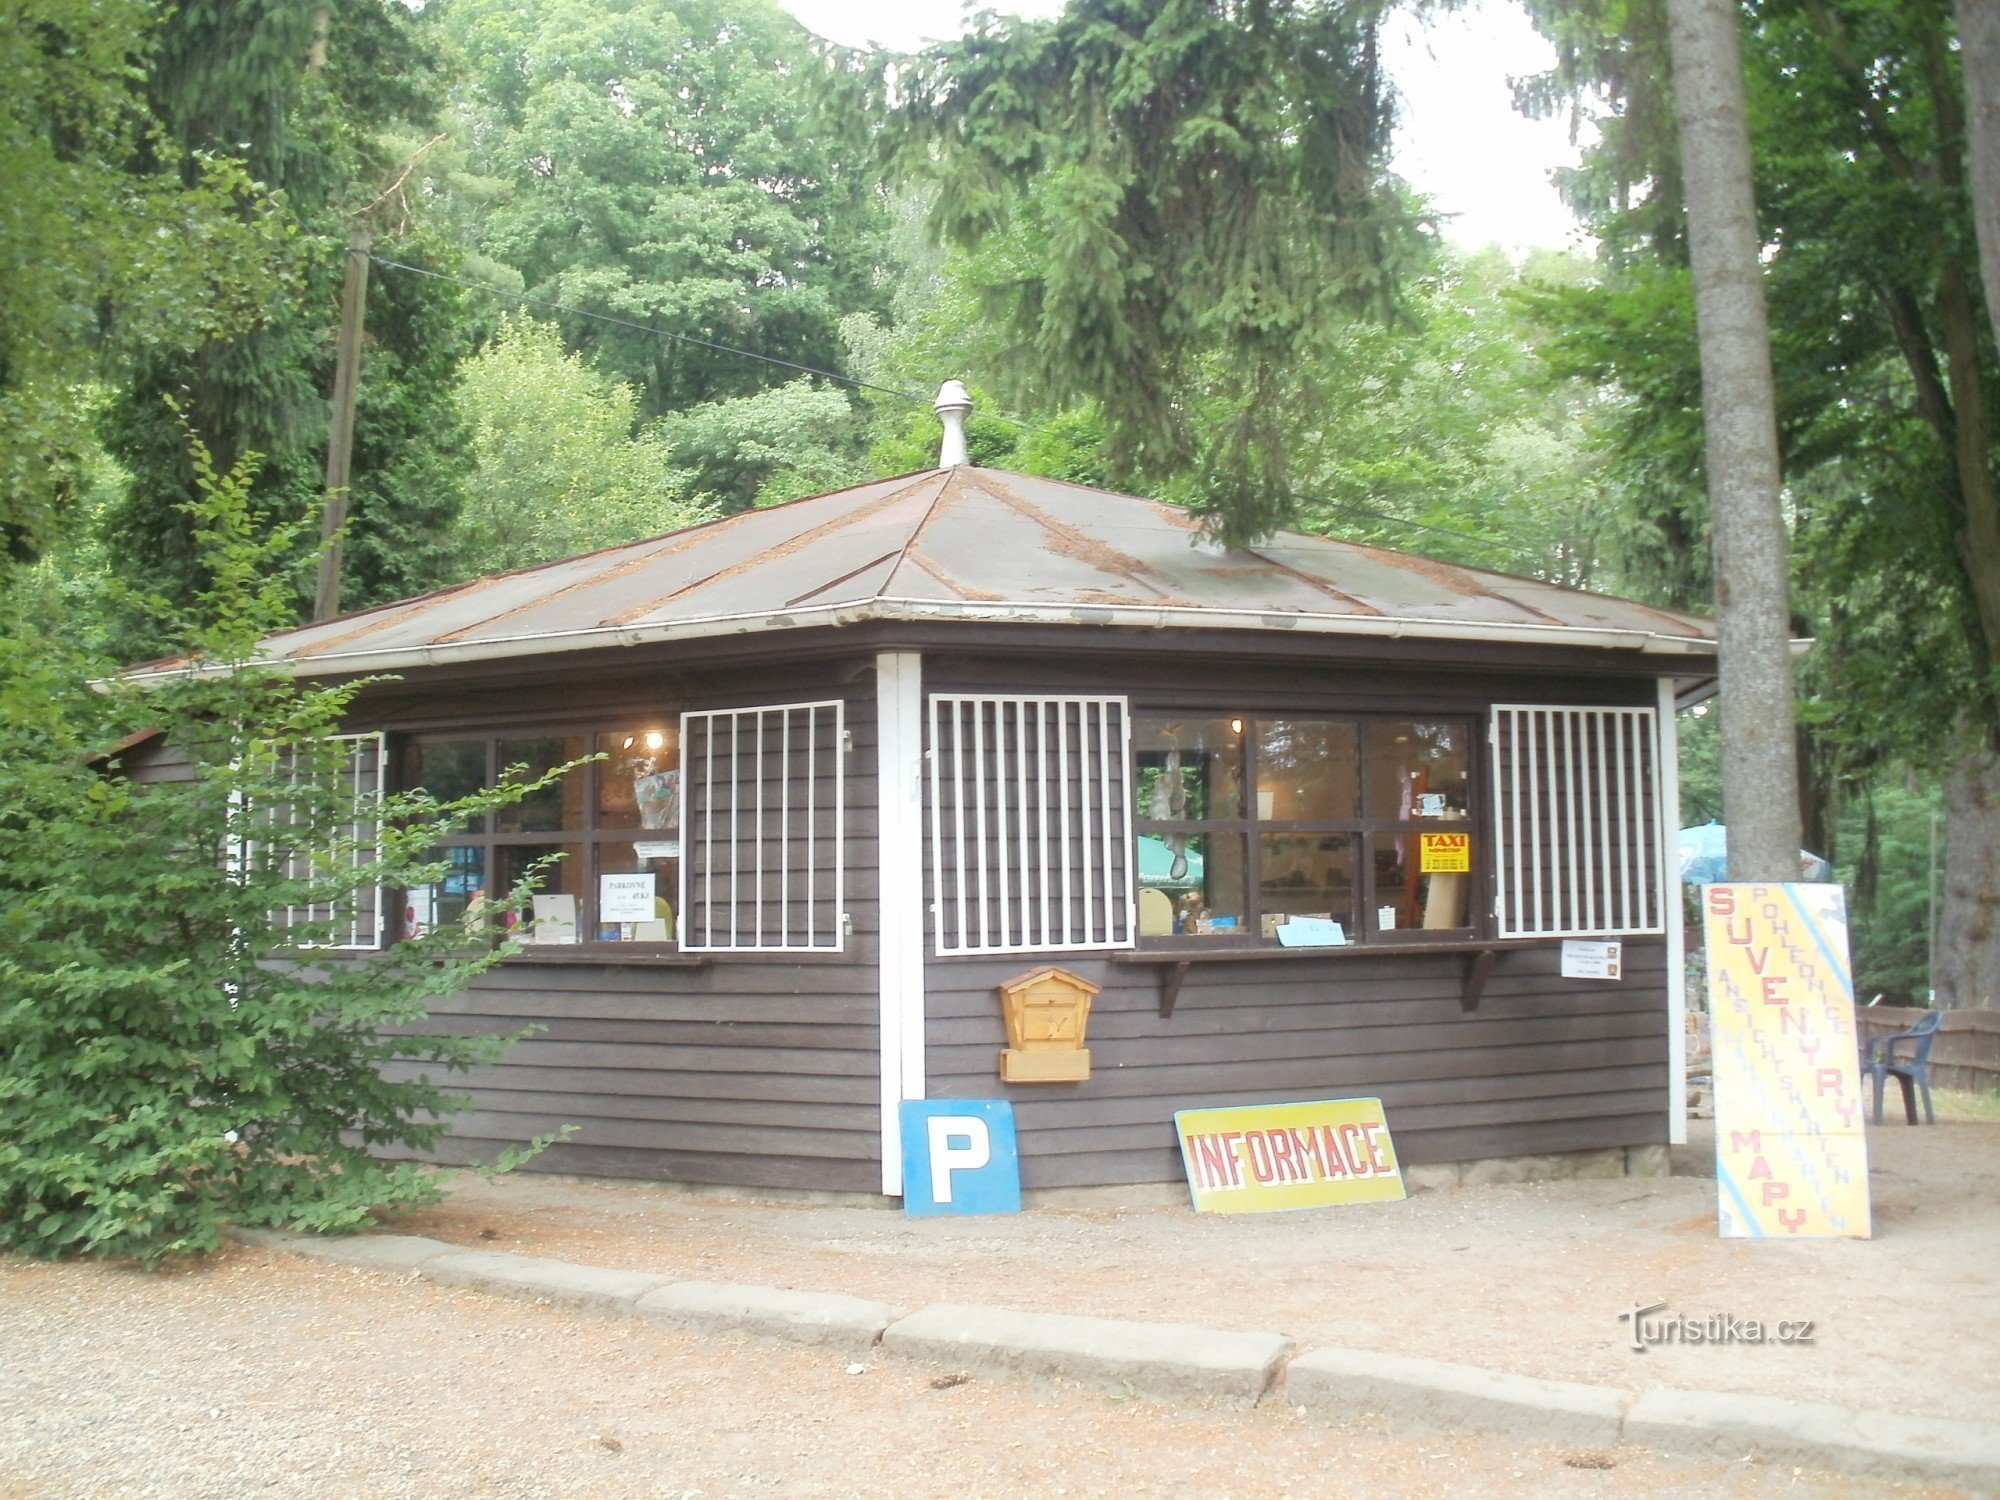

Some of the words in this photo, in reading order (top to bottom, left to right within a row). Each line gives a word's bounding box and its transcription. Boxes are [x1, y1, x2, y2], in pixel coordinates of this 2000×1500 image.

[1423, 835, 1465, 847] TAXI
[1709, 887, 1857, 1128] SUVENYRY
[1751, 887, 1849, 1035] POHLEDNICE
[1718, 969, 1849, 1184] ANSICHTSKARTEN
[925, 1115, 991, 1203] P
[1186, 1122, 1397, 1192] INFORMACE
[1730, 1129, 1806, 1233] MAPY
